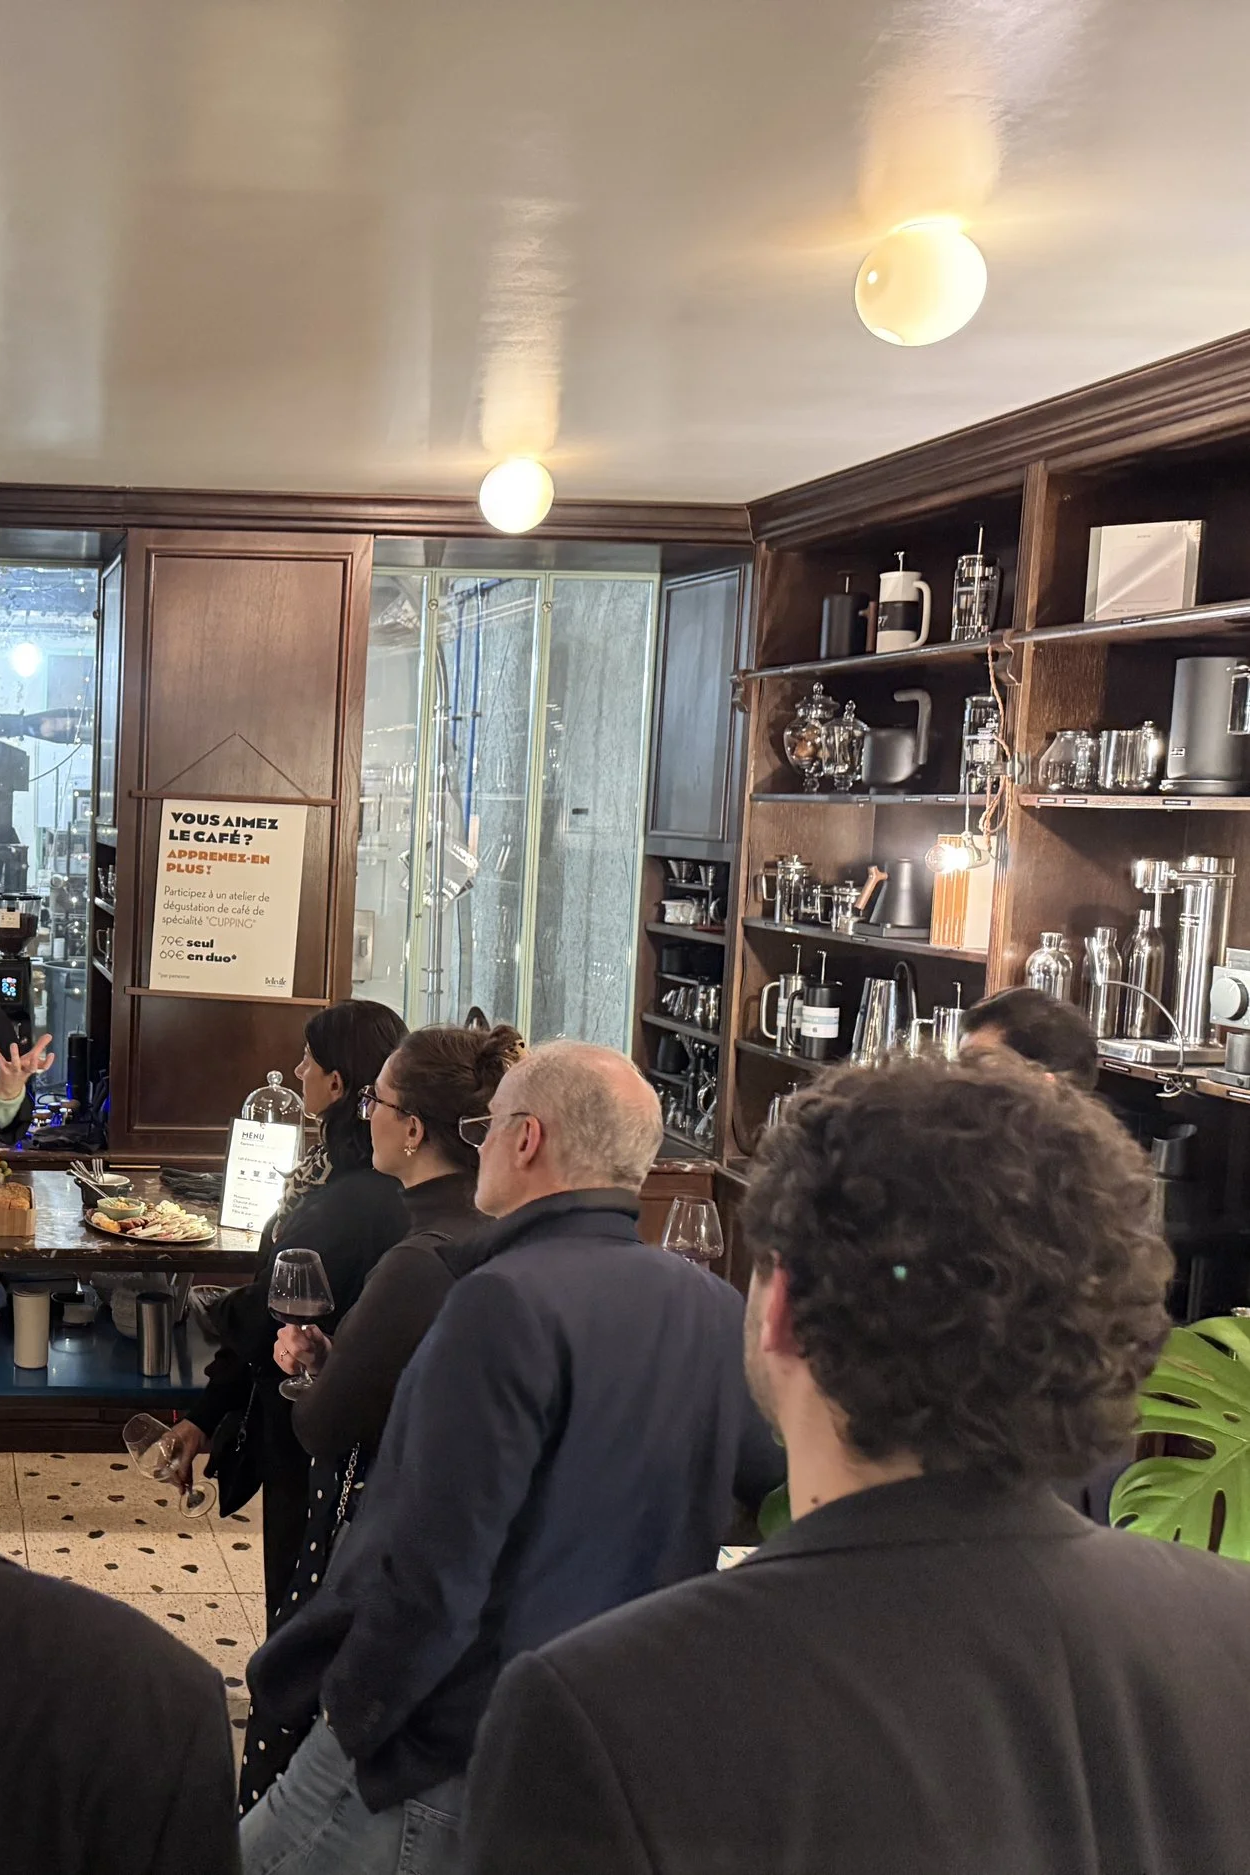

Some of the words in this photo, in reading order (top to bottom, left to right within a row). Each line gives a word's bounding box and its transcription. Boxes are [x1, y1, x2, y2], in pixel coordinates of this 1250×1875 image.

[171, 812, 220, 826] VOUS
[222, 815, 279, 830] AIMEZ
[168, 829, 190, 841] LE
[193, 829, 241, 845] CAFÉ
[167, 849, 270, 865] APPRENEZ-EN
[166, 862, 205, 875] PLUS
[164, 885, 206, 899] Participez
[208, 889, 214, 899] à
[228, 890, 256, 901] atelier
[257, 892, 270, 902] de
[163, 900, 214, 913] dégustation
[217, 903, 229, 914] de
[231, 904, 250, 915] café
[252, 905, 265, 916] de
[162, 915, 203, 926] spécialité
[160, 935, 184, 946] 79€
[186, 939, 214, 948] seul
[159, 950, 185, 960] 69€
[187, 953, 203, 961] en
[241, 1131, 265, 1141] MENU
